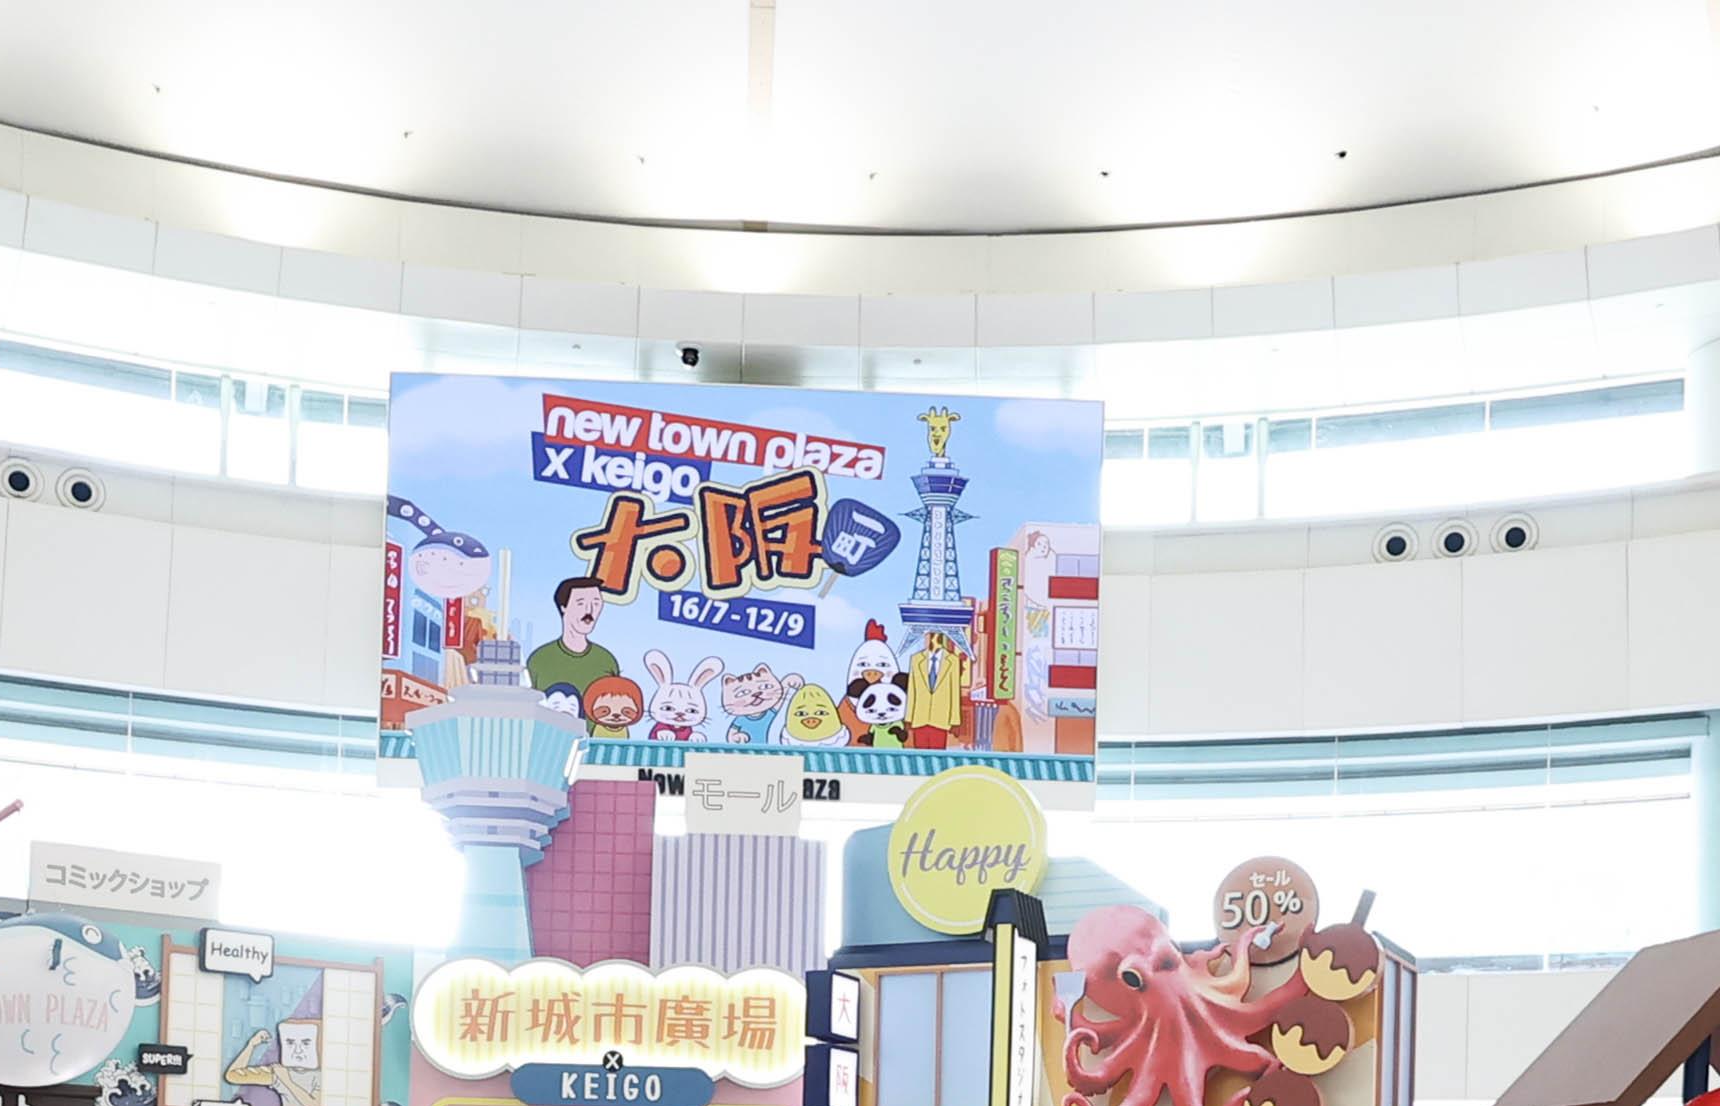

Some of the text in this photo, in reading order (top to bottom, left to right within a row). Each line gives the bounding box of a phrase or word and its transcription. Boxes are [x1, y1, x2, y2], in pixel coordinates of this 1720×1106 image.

[546, 406, 884, 480] new town plaza
[580, 446, 701, 502] keigo
[692, 778, 798, 813] モール
[900, 828, 1031, 885] Happy
[45, 864, 210, 901] コミックショップ
[1249, 870, 1291, 888] セール
[210, 941, 269, 964] Healthy
[44, 993, 110, 1033] PLAZA
[459, 988, 777, 1051] 新城市廣場
[838, 992, 851, 1024] 大
[560, 1071, 662, 1102] KEIGO
